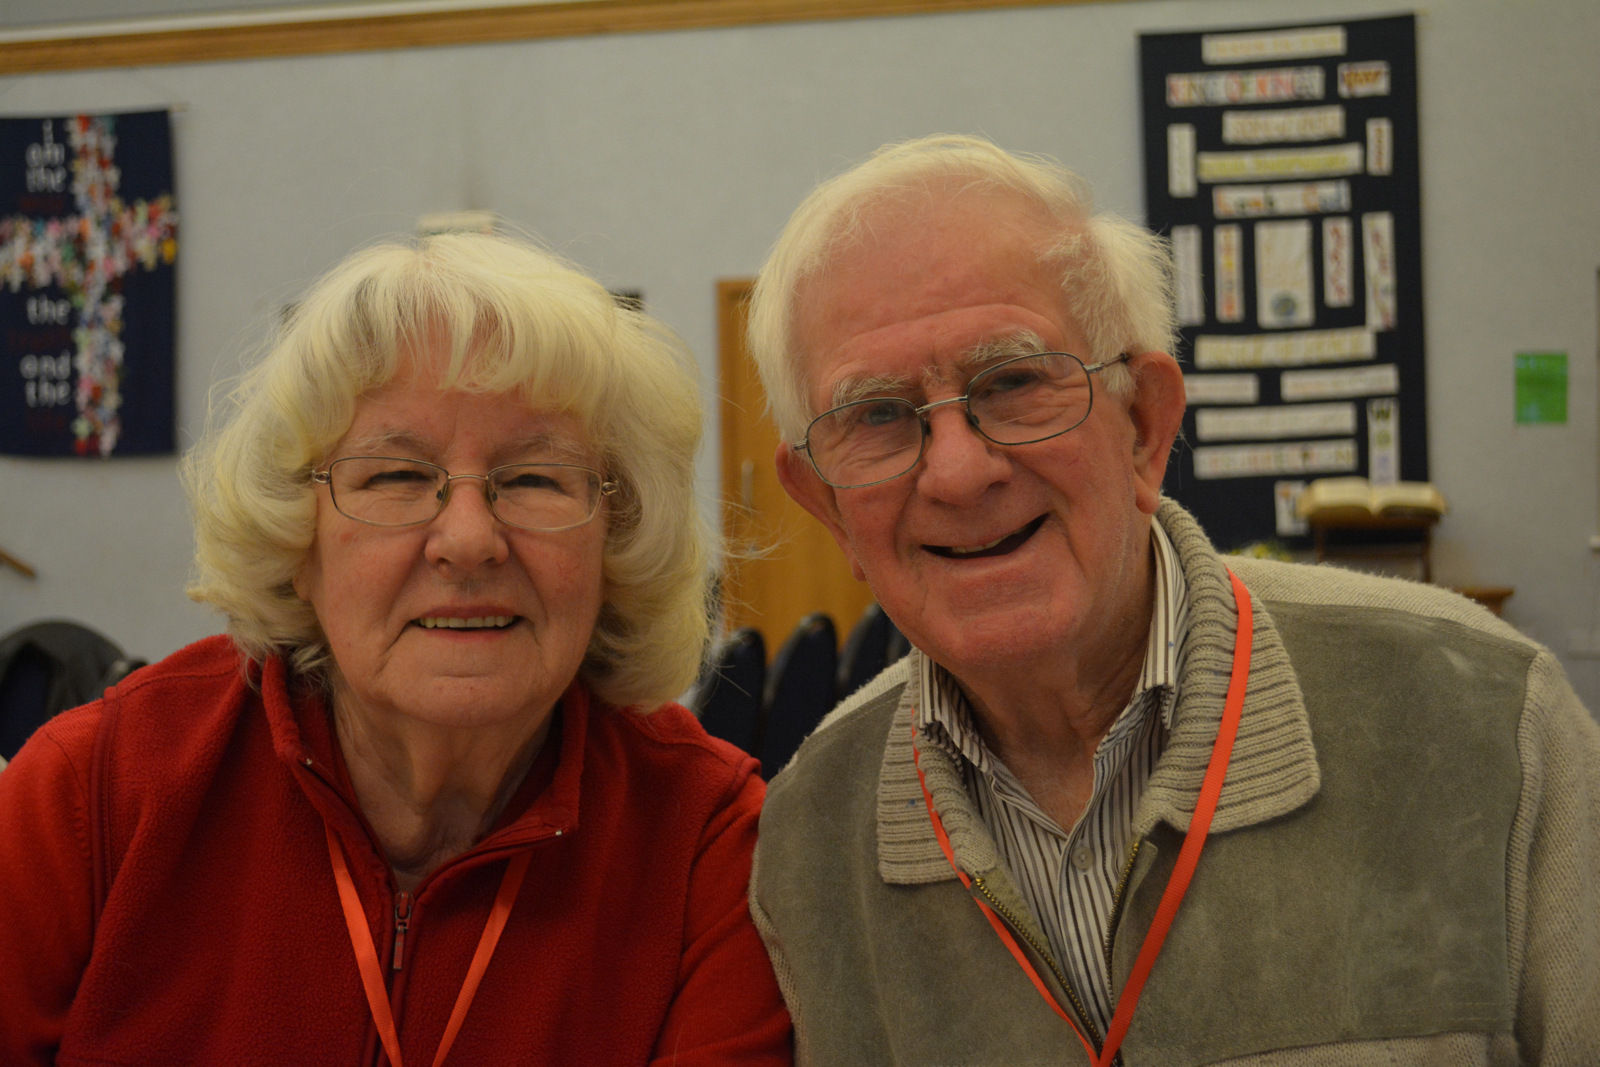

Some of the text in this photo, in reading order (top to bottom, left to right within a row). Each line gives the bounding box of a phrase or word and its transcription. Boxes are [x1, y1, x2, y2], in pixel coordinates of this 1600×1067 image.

[26, 165, 67, 192] the
[27, 295, 71, 325] the
[20, 350, 71, 380] and
[25, 377, 71, 408] the
